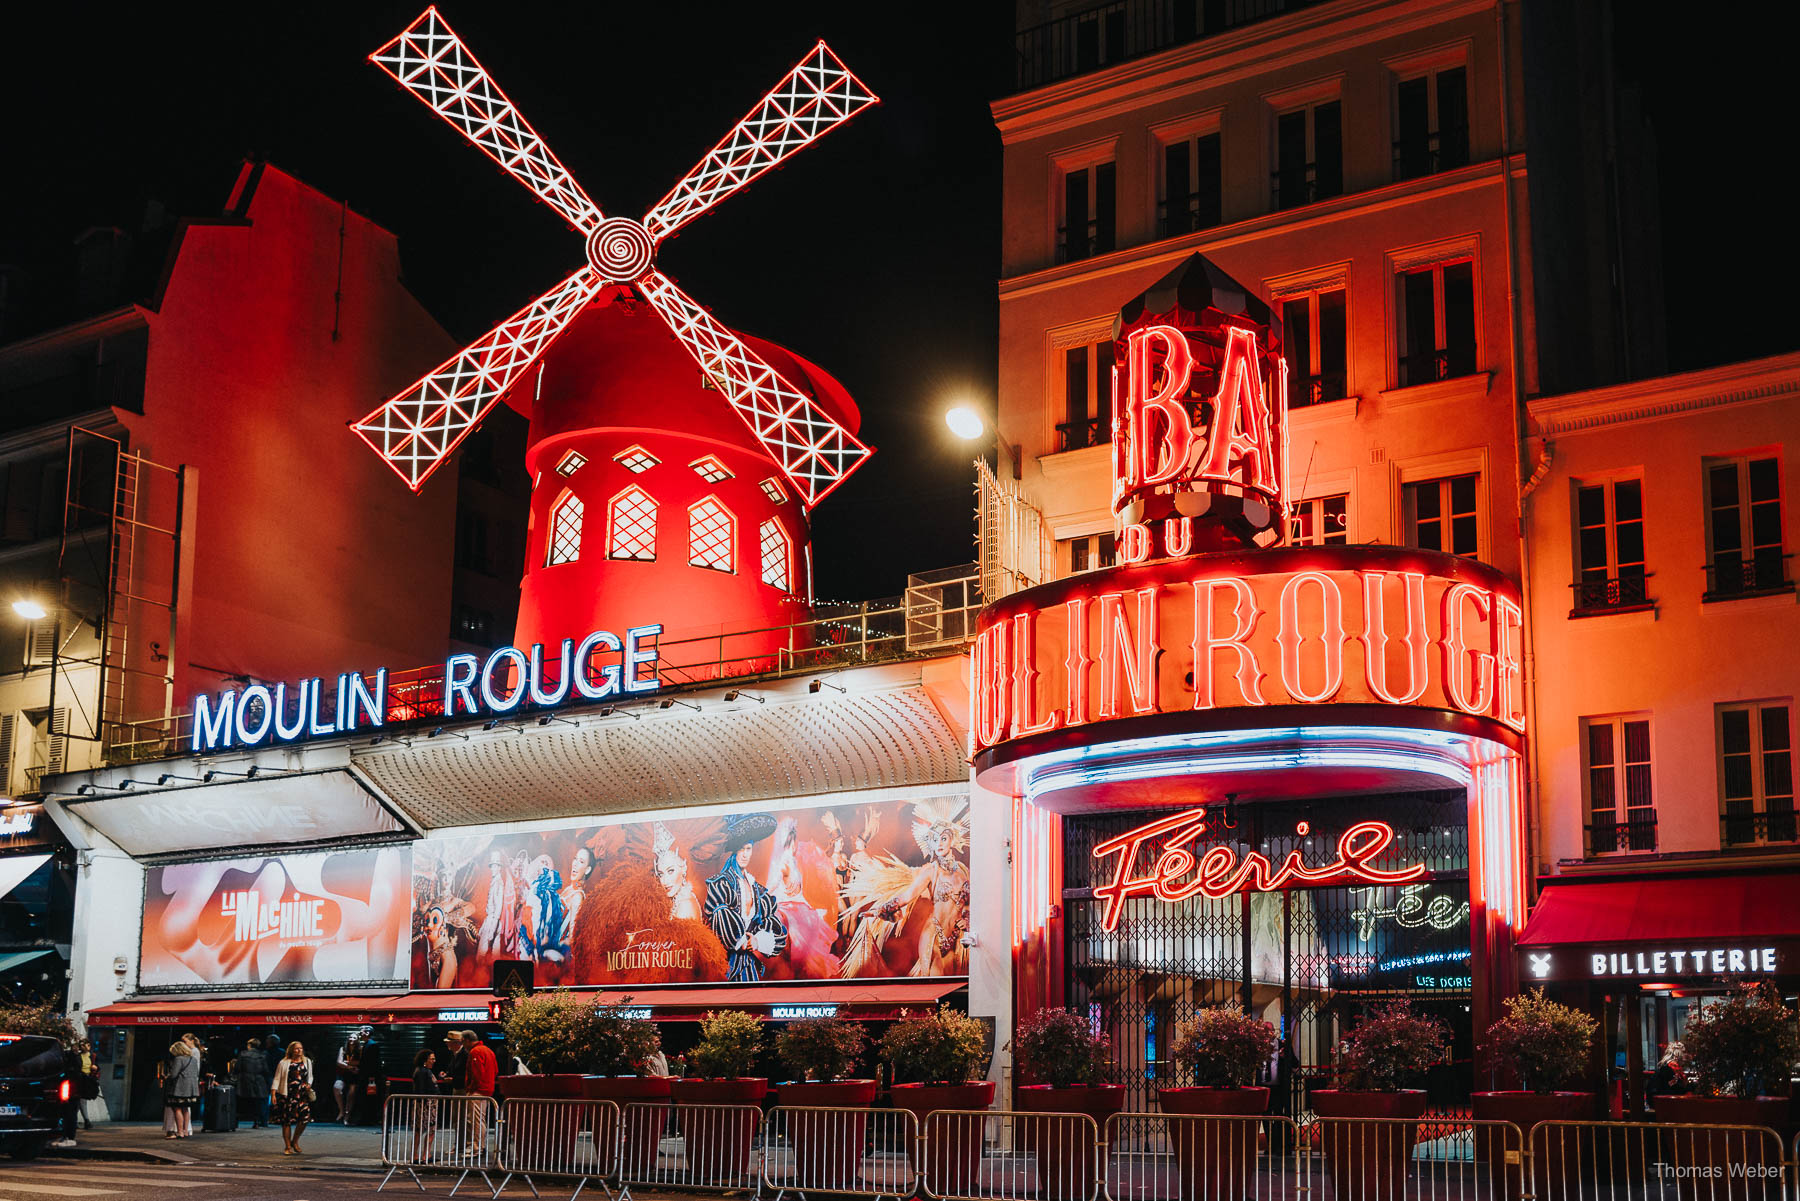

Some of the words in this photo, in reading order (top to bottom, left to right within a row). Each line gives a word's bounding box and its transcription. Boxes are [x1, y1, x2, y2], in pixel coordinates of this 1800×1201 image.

[1123, 516, 1193, 563] DU
[1191, 571, 1527, 732] ROUGE
[191, 666, 389, 751] MOULIN
[444, 624, 664, 717] ROUGE
[1092, 807, 1427, 934] Féerie
[221, 892, 236, 913] LA
[619, 928, 677, 958] Forever
[606, 950, 650, 972] MOULIN
[651, 947, 694, 970] ROUGE
[1591, 948, 1777, 976] BILLETTERIE
[1415, 976, 1435, 987] LES
[137, 1015, 159, 1023] MOULIN
[160, 1015, 179, 1023] ROUGE
[265, 1015, 290, 1023] MOULIN
[290, 1015, 313, 1023] ROUGE
[438, 1011, 464, 1021] MOULIN
[464, 1011, 489, 1021] ROUGE
[773, 1007, 806, 1018] MOULIN
[806, 1007, 837, 1018] ROUGE
